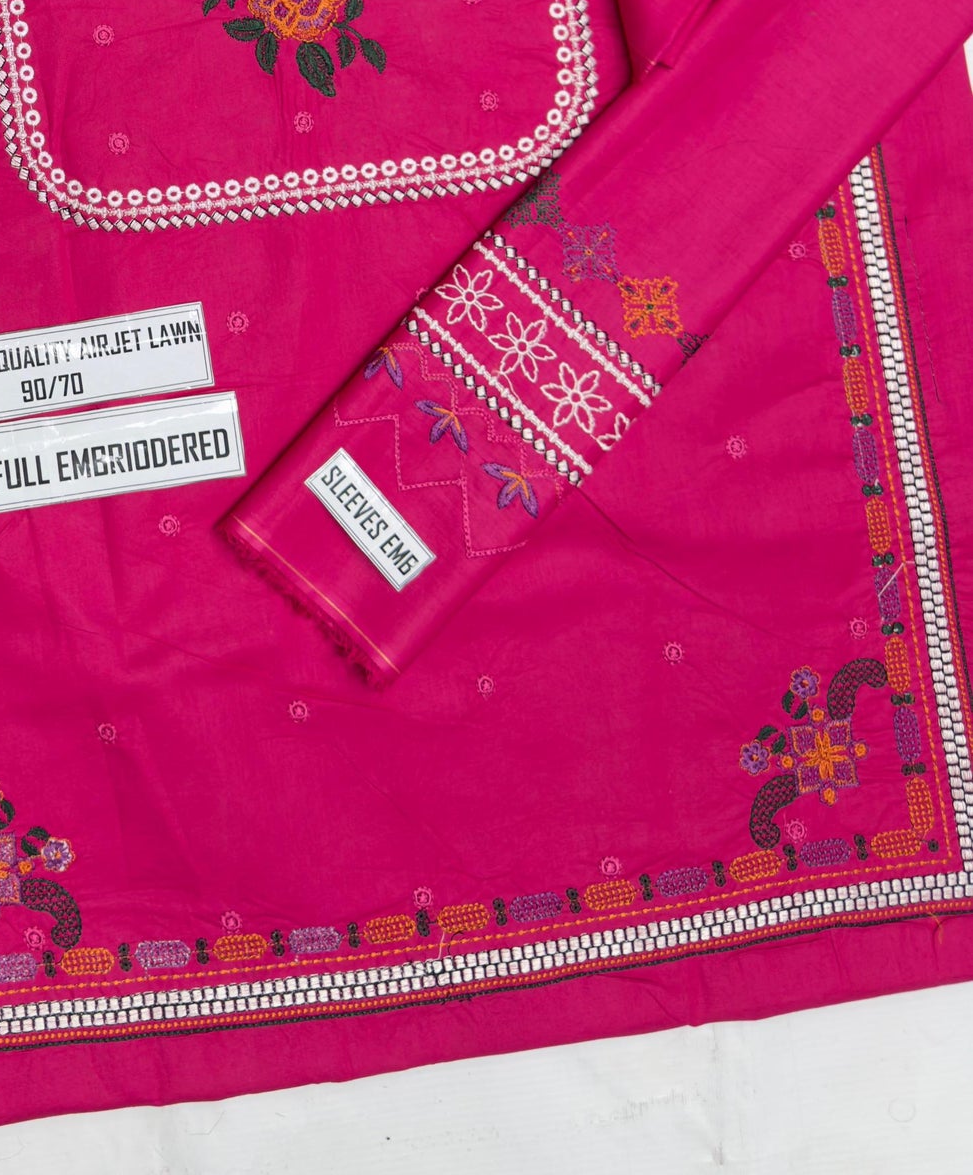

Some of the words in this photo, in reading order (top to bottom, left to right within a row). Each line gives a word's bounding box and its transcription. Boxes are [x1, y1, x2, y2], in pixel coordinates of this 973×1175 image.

[80, 328, 142, 361] AIRJET
[147, 319, 203, 350] LAWN
[21, 372, 84, 403] 90/70
[56, 428, 231, 483] EMBRIODERED
[321, 465, 389, 541] SLEEVES
[379, 532, 419, 576] EMB
